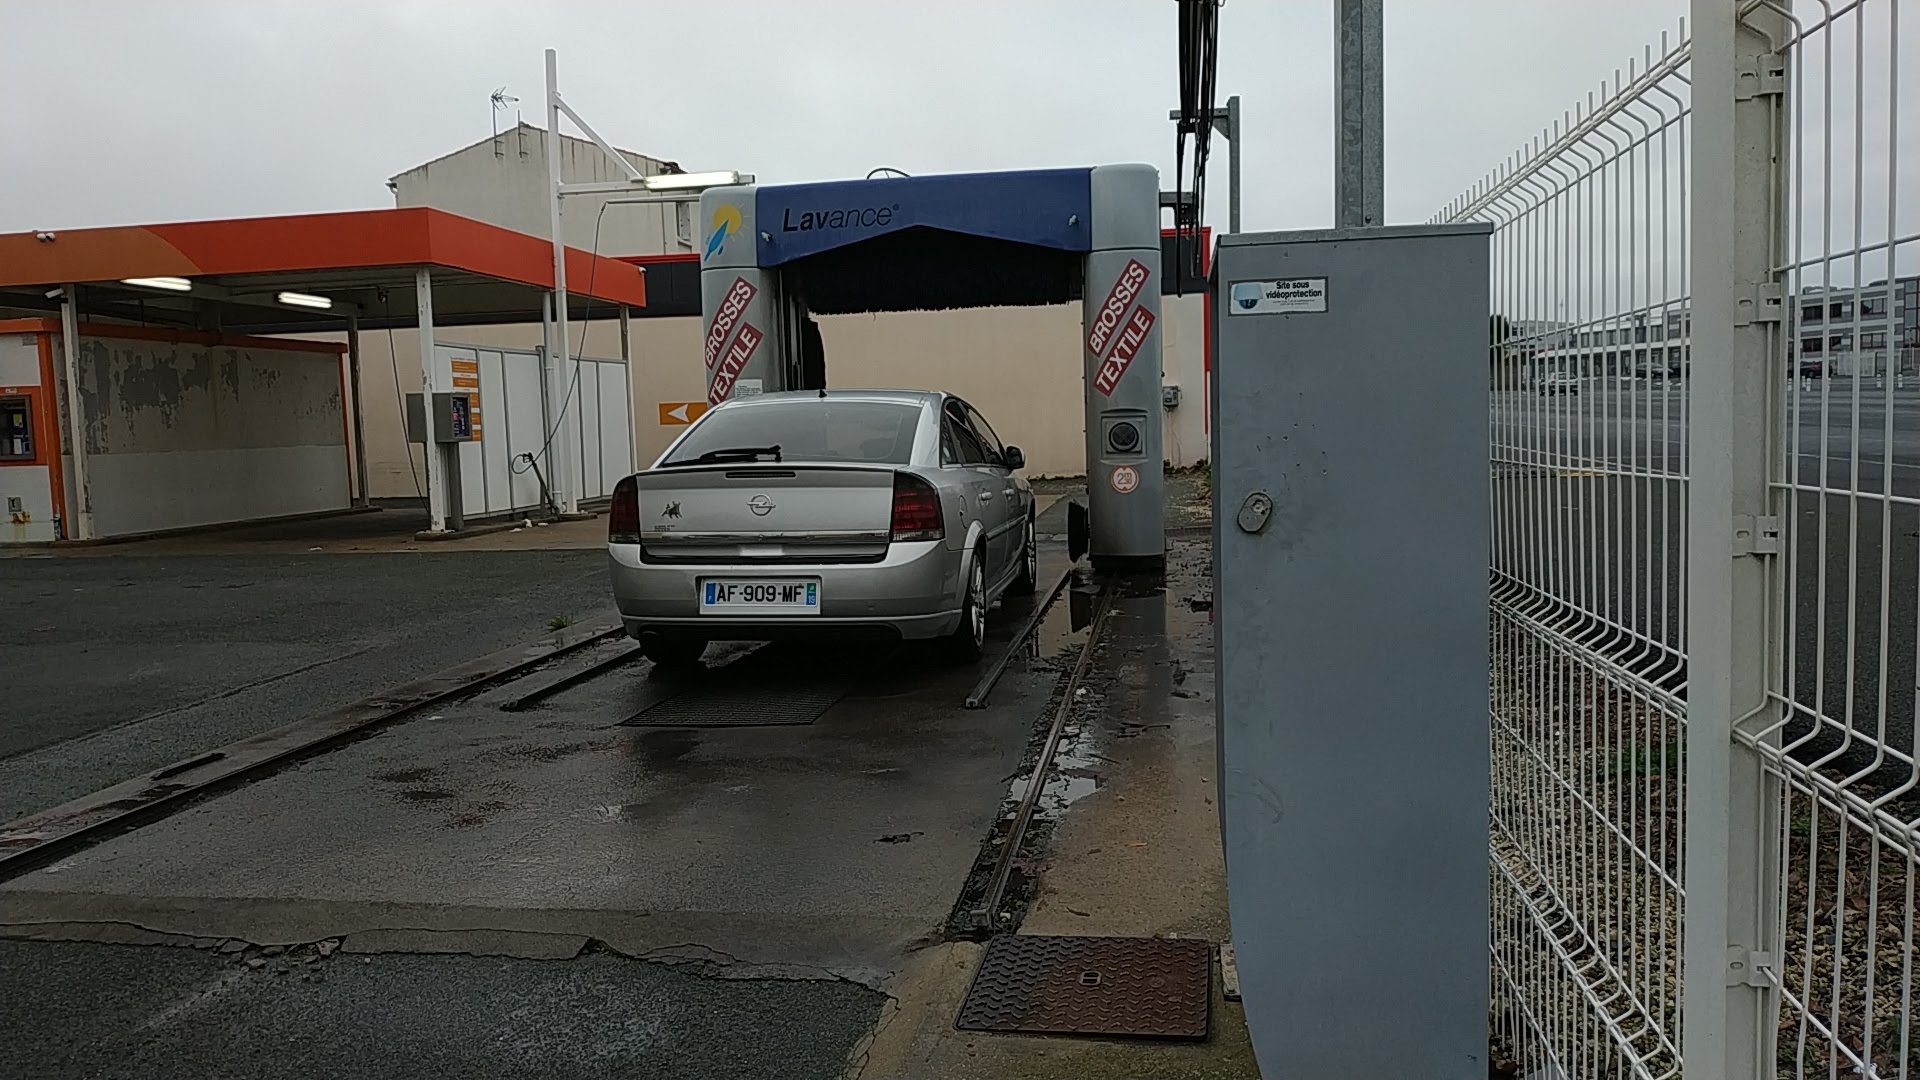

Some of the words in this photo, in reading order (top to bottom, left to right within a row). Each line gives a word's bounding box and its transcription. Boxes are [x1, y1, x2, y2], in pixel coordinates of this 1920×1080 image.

[783, 206, 891, 232] Lavance
[1090, 263, 1144, 353] BROSSES
[1266, 289, 1322, 299] vidéoprotection
[1276, 281, 1290, 289] Site
[706, 281, 751, 364] BROSSES
[709, 328, 756, 404] TEXTILE
[1096, 310, 1150, 392] TEXTILE
[716, 585, 804, 602] AF-909-MF
